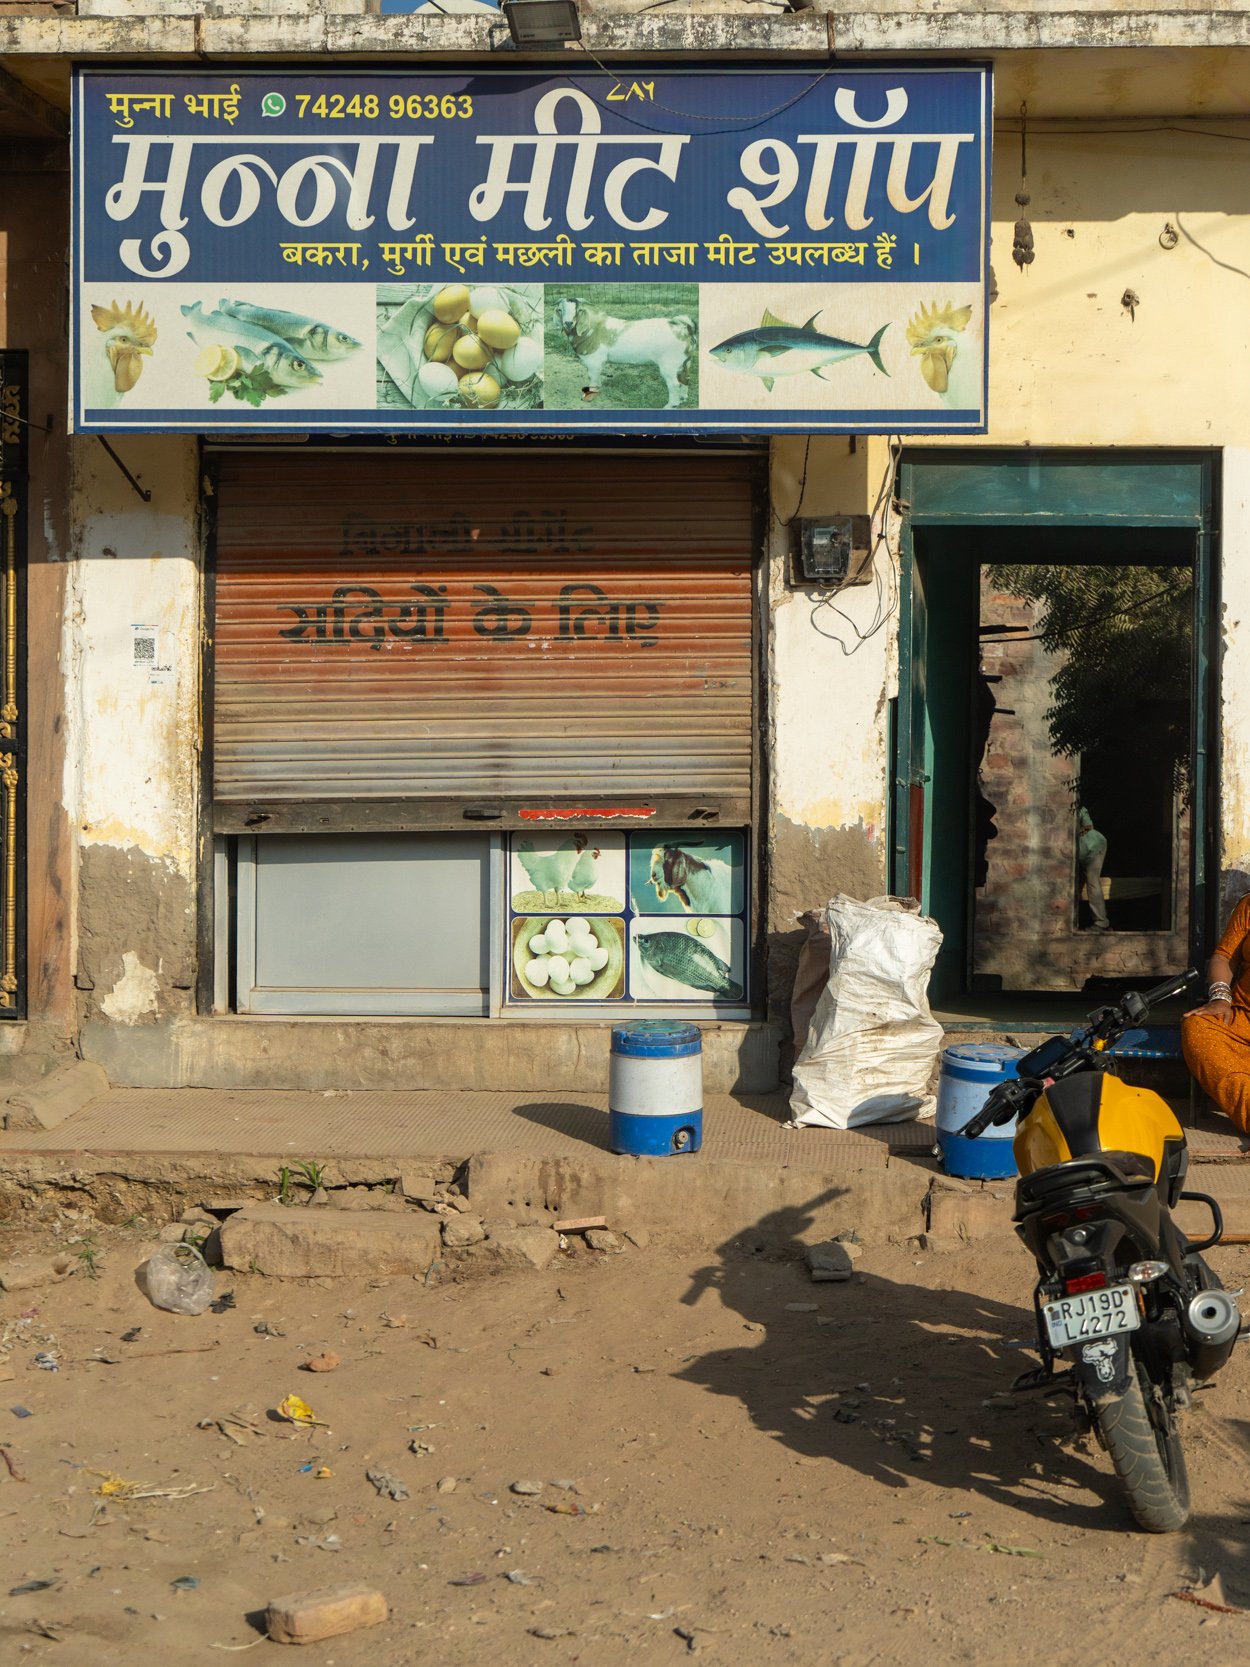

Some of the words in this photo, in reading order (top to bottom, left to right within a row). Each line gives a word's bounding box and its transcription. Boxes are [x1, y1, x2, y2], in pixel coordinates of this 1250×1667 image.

[105, 93, 175, 128] मुन्ना
[184, 84, 242, 126] भाई
[295, 94, 380, 119] 74248
[388, 94, 474, 119] 96363
[104, 134, 435, 278] मुन्ना
[469, 87, 692, 231] मीट
[727, 86, 975, 238] शॉप
[279, 243, 369, 271] बकरा,
[378, 233, 436, 275] मुर्गी
[440, 235, 487, 274] एवं
[492, 233, 576, 266] मछली
[581, 243, 625, 266] का
[630, 243, 699, 266] ताजा
[703, 233, 760, 266] मीट
[764, 242, 869, 266] उपलब्ध
[470, 584, 536, 642] के
[552, 584, 666, 648] लिए
[1060, 1289, 1124, 1321] RJ19D
[1064, 1310, 1128, 1340] L4272
